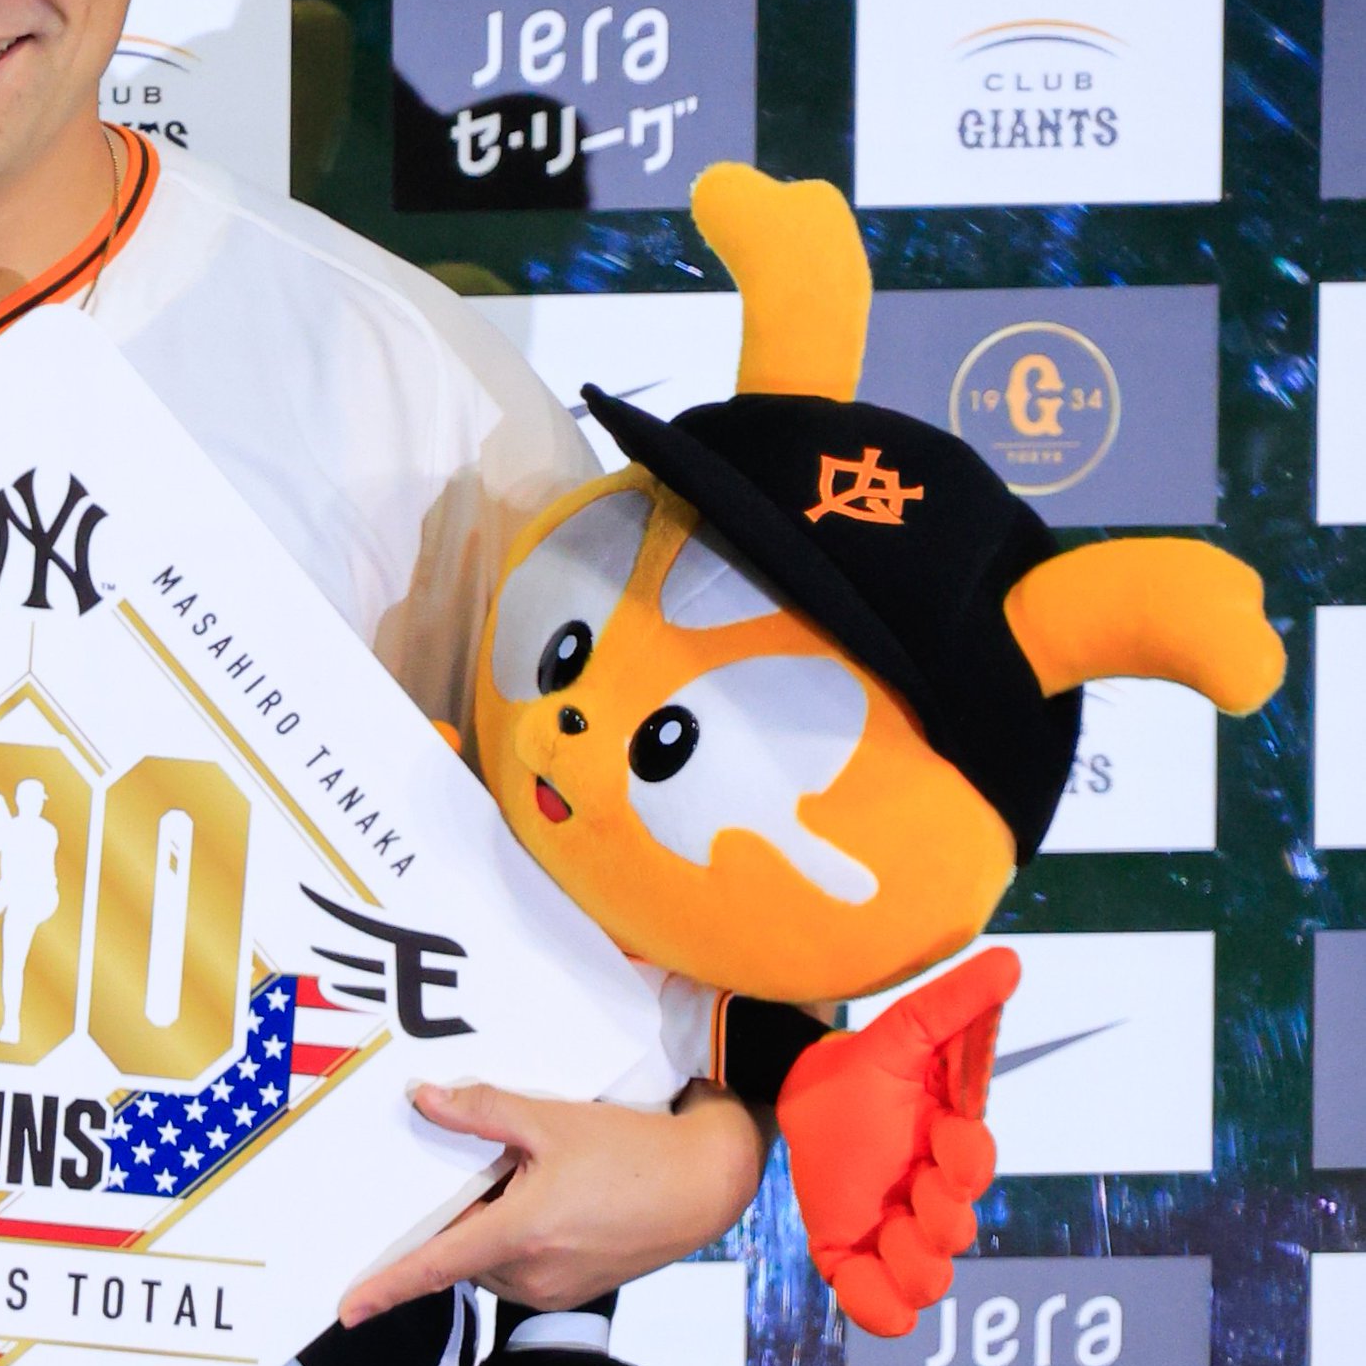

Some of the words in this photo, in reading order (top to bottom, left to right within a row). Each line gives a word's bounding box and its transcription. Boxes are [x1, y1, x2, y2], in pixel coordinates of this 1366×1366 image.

[984, 72, 1092, 92] CLUB
[450, 96, 697, 178] セ・リーグ
[958, 107, 1118, 149] GIANTS
[971, 390, 1000, 411] 19
[1071, 389, 1102, 410] 34
[154, 565, 301, 737] MASAHIRO
[309, 744, 418, 879] TANAKA
[70, 1273, 234, 1332] TOTAL
